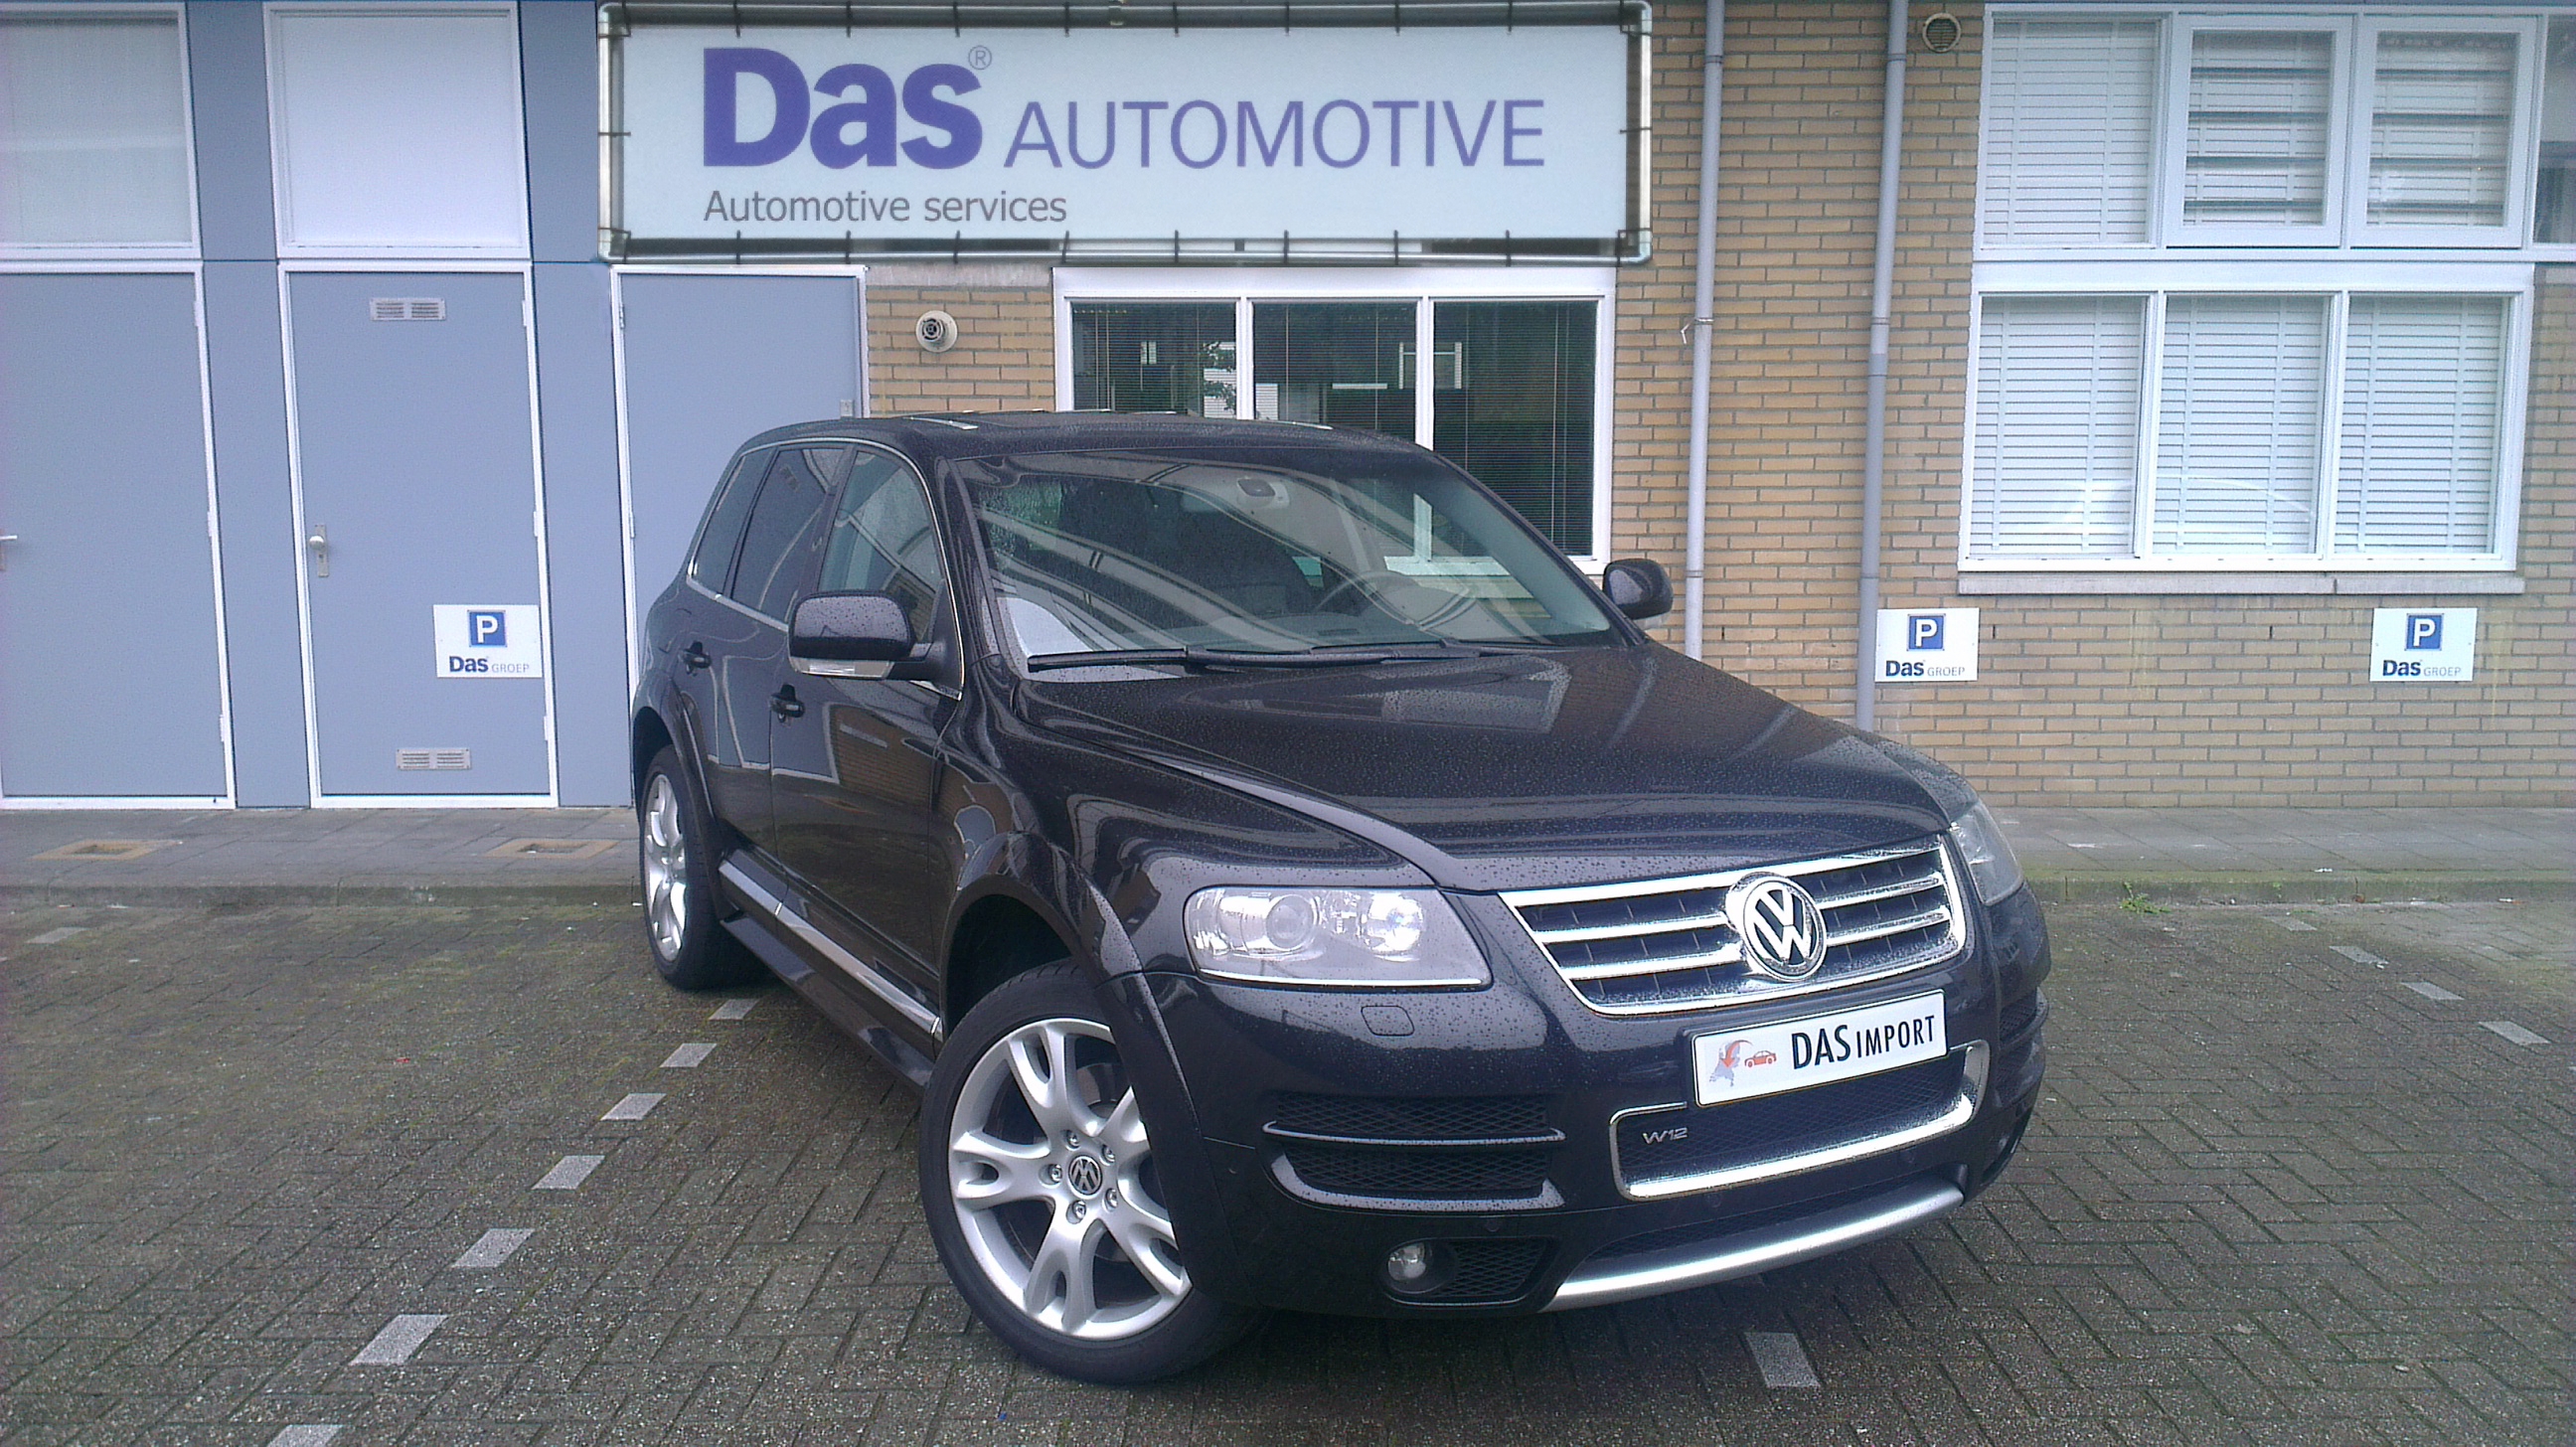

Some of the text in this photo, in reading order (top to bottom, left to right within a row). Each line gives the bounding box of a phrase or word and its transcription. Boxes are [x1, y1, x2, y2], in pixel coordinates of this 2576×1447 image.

[1003, 99, 1545, 170] AUTOMOTIVE
[703, 190, 1067, 223] Automotive services
[476, 614, 499, 644] P
[1915, 618, 1938, 648] P
[2412, 617, 2436, 648] P
[449, 655, 530, 674] Das GROEP
[1885, 660, 1966, 678] Das GROEP
[2382, 659, 2462, 678] Das GROEP
[1791, 1014, 1936, 1069] DAS IMPORT
[1642, 1127, 1689, 1145] W12
